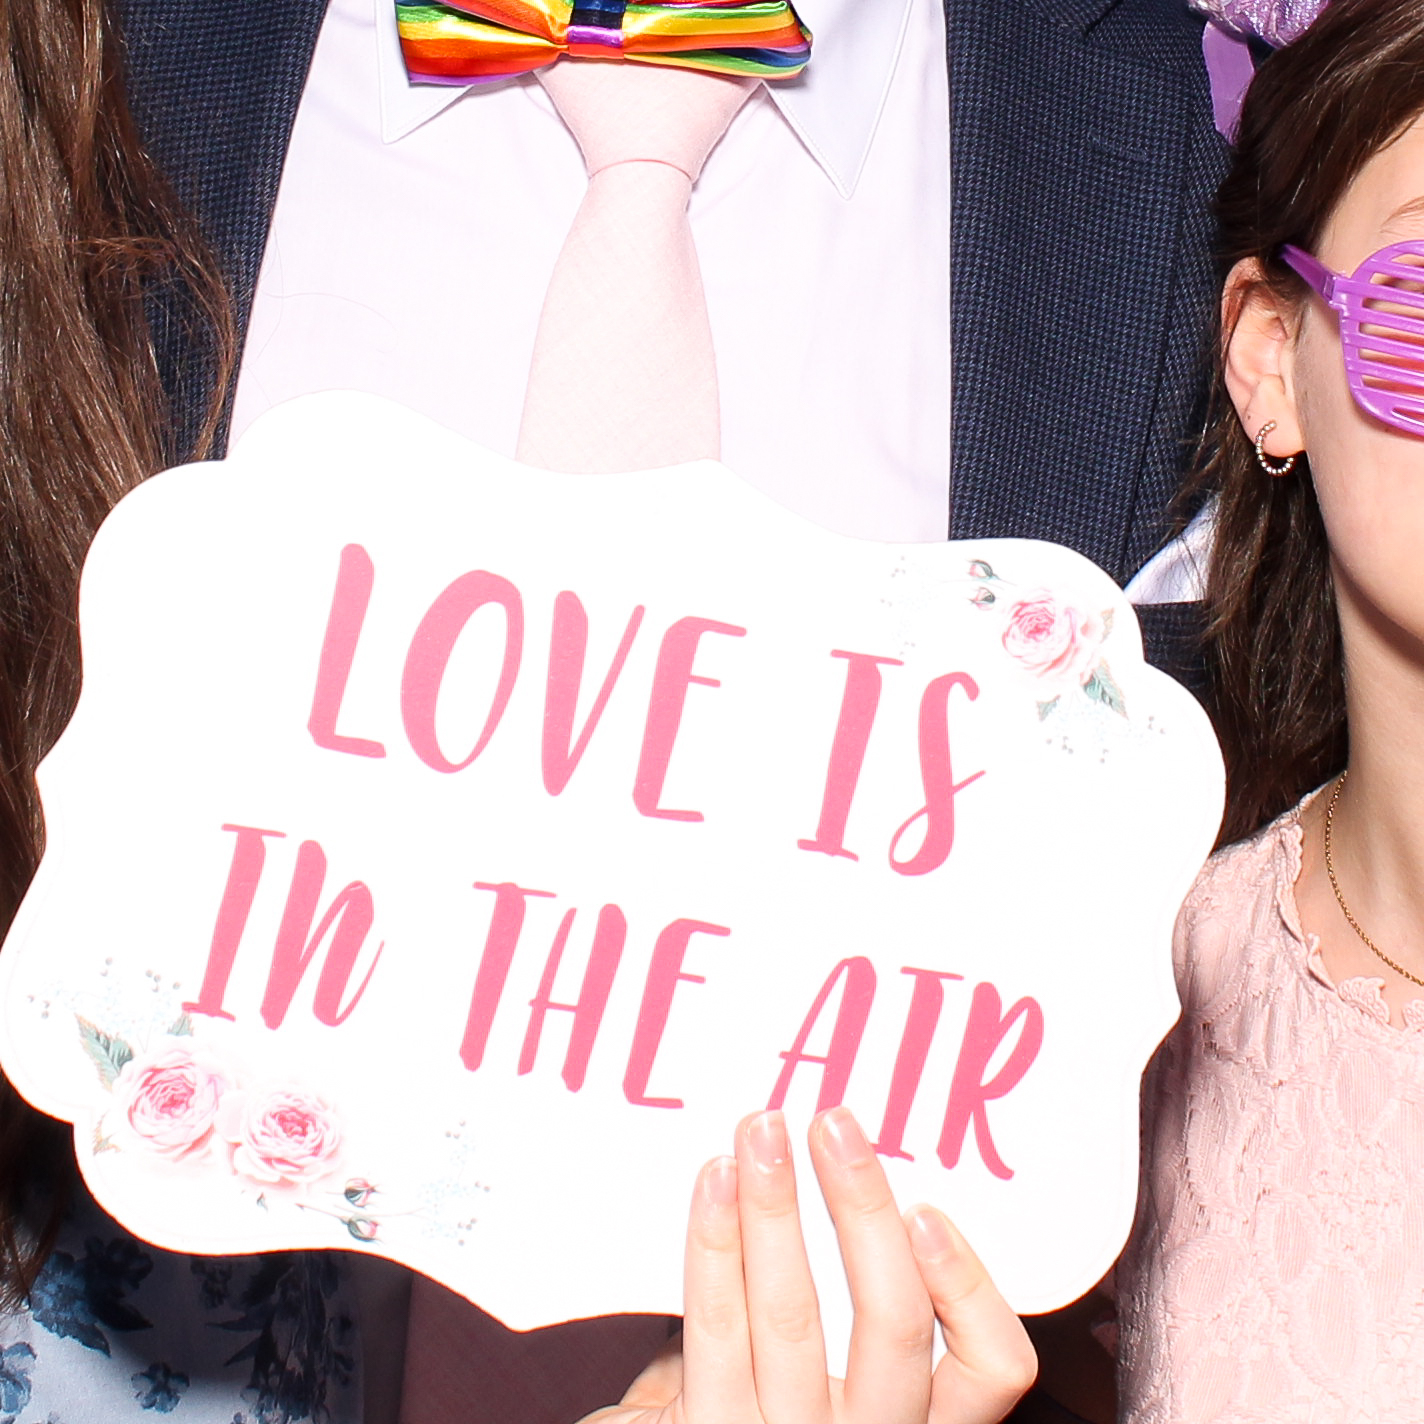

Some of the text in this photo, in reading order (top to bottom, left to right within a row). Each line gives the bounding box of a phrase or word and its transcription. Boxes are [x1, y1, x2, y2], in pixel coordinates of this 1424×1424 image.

[306, 542, 987, 877] LOVE IS
[458, 880, 732, 1111] THE
[764, 955, 1046, 1182] AIR
